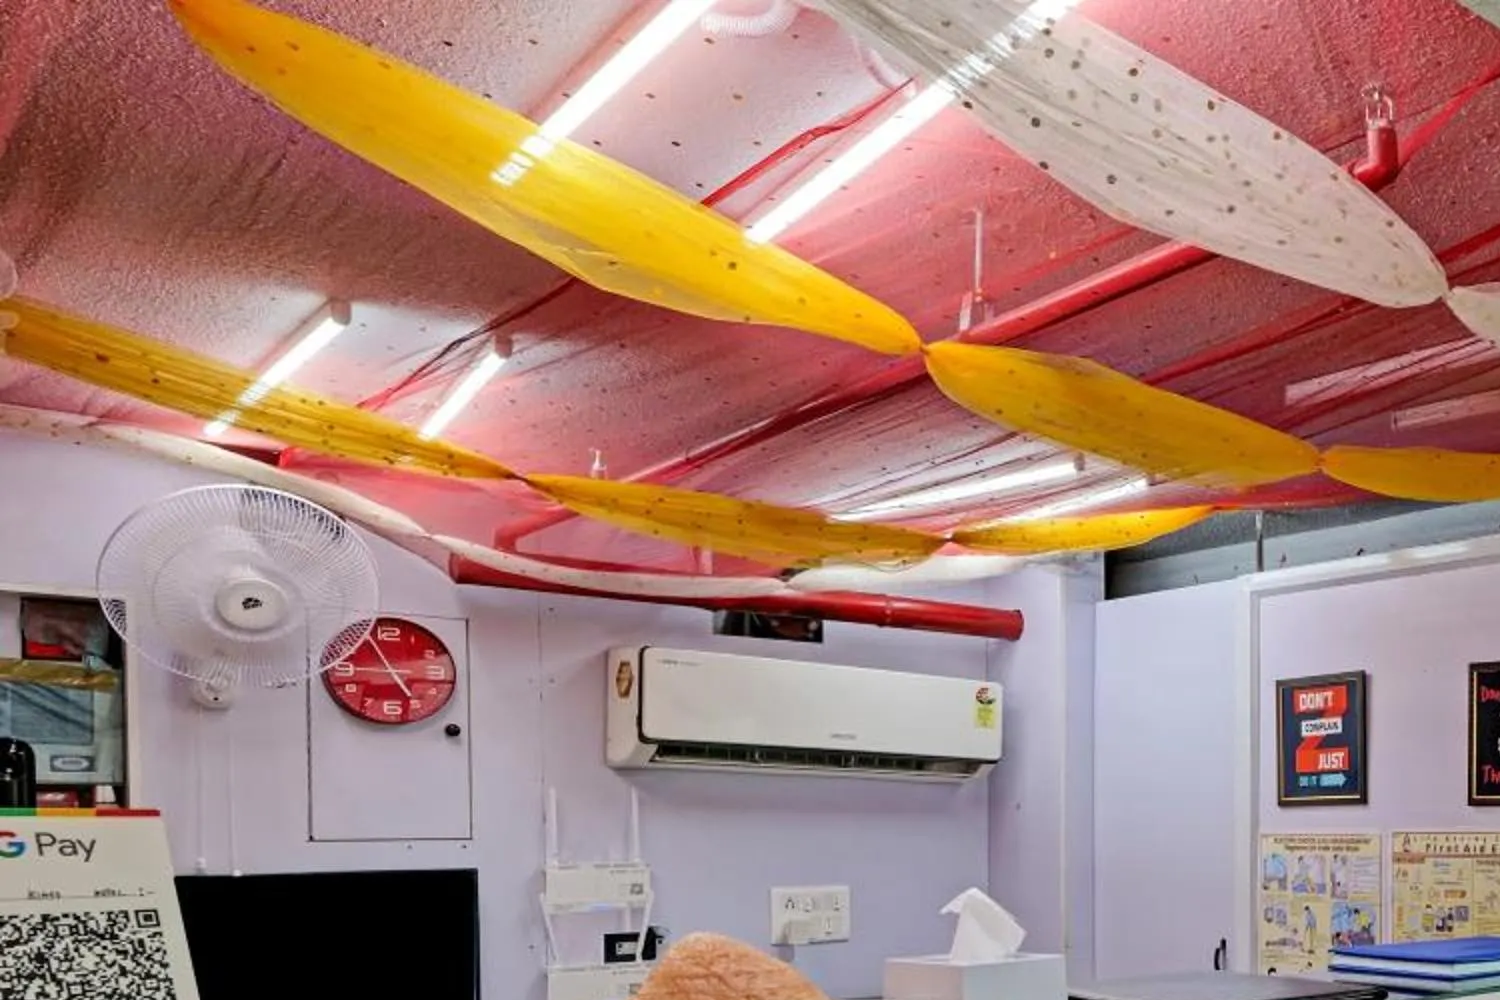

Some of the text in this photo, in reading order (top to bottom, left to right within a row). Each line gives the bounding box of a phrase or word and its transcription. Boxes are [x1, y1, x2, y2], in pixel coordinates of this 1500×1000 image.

[378, 626, 401, 641] 12
[426, 665, 445, 680] 3
[383, 701, 402, 715] 6
[1317, 751, 1346, 770] JUST
[34, 832, 97, 863] Pay
